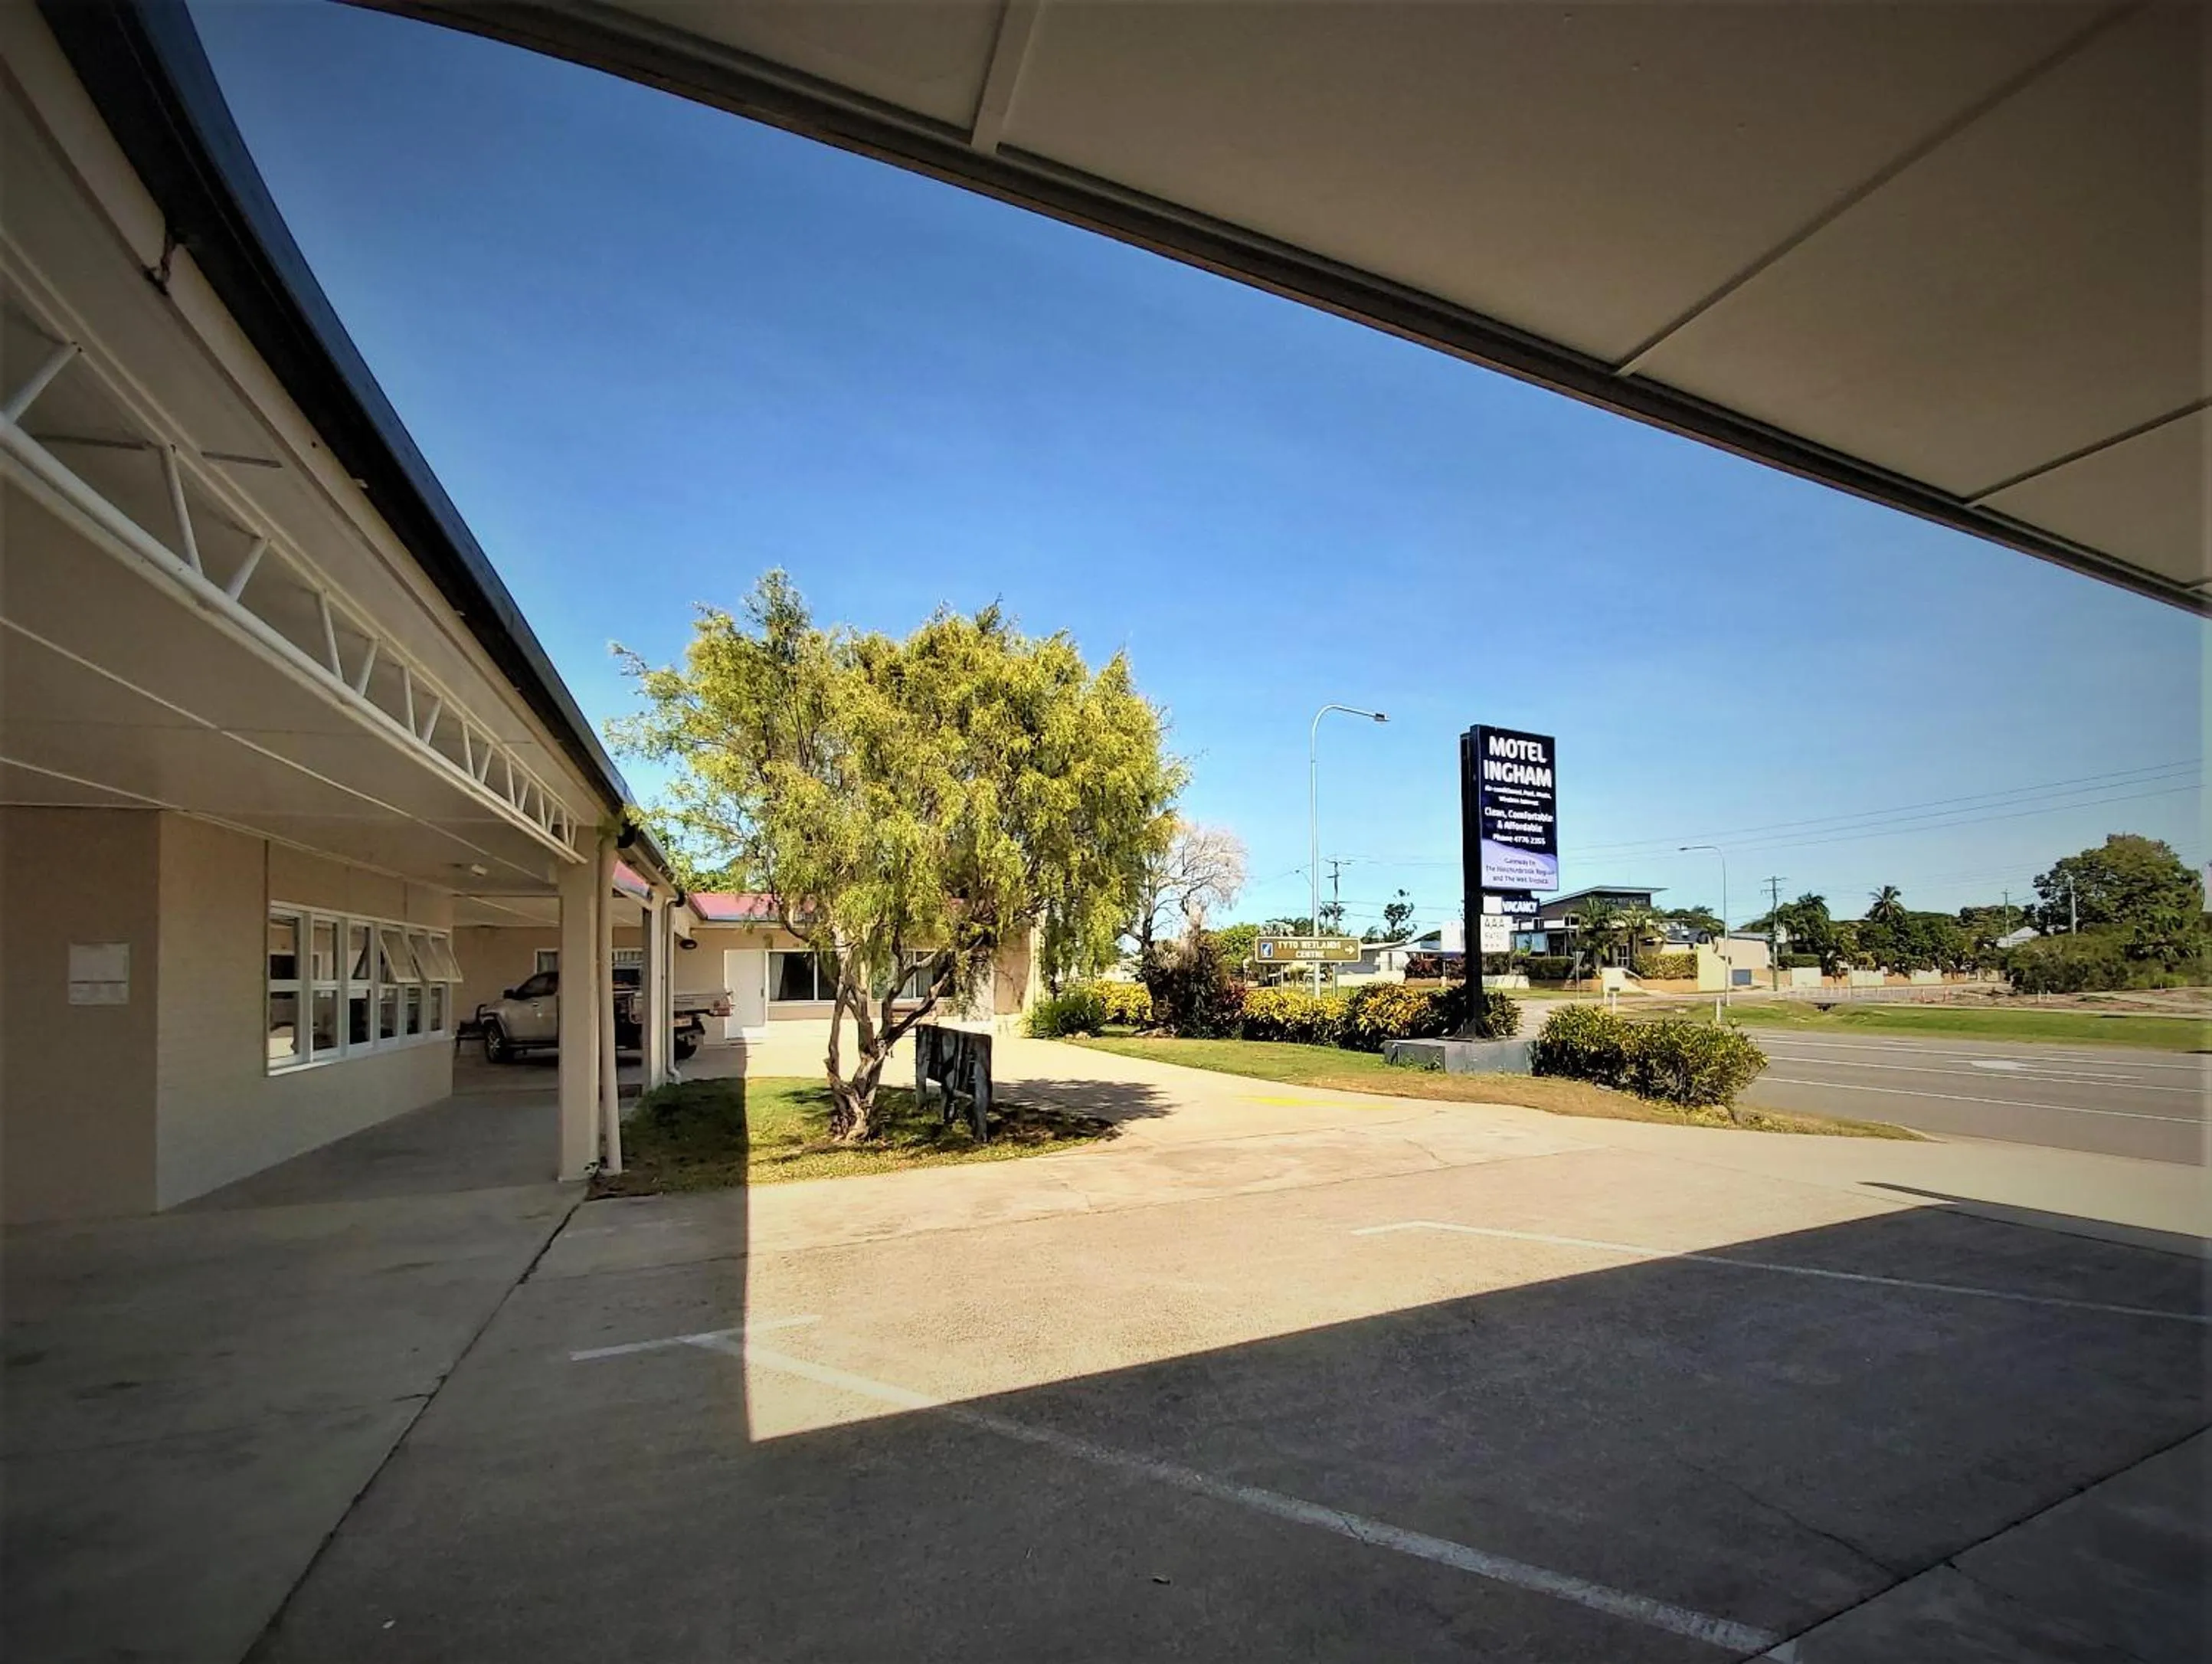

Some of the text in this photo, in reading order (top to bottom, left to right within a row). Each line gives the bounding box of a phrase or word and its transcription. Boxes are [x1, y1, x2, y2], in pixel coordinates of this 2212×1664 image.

[1489, 735, 1547, 763] MOTEL
[1484, 759, 1552, 788] INGHAM
[1485, 807, 1553, 822] Clean, Comfortable
[1497, 820, 1543, 833] & Affordable
[1493, 834, 1513, 843] Phone
[1502, 901, 1538, 913] VACANCY
[1277, 941, 1340, 949] TYTO WETLANDS
[1295, 950, 1325, 958] CENTRE
